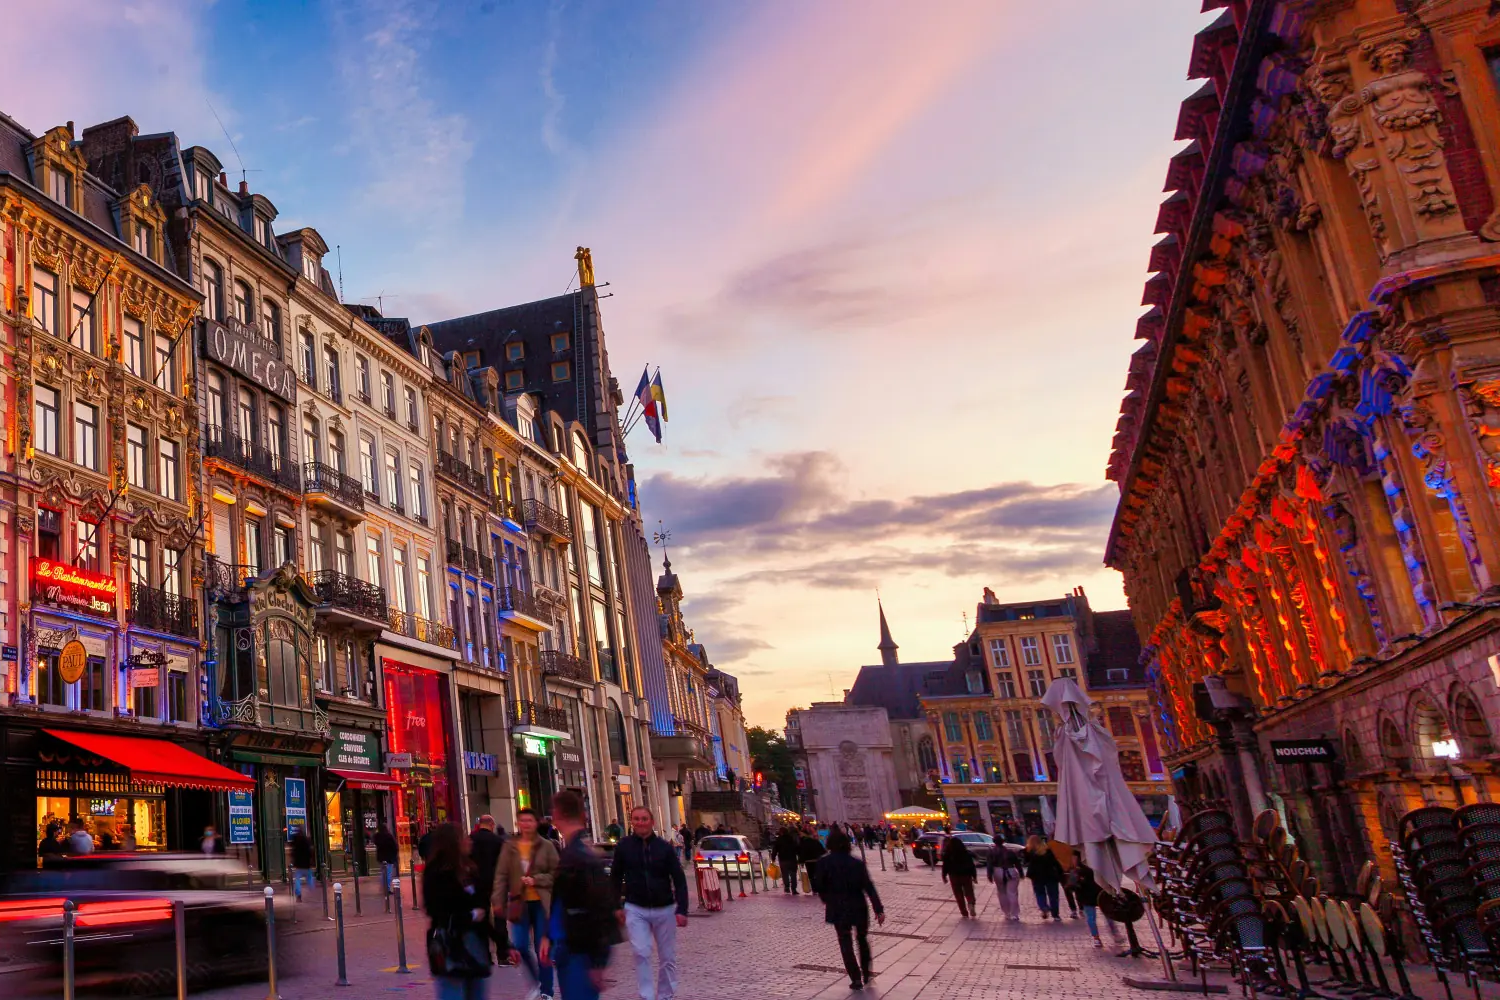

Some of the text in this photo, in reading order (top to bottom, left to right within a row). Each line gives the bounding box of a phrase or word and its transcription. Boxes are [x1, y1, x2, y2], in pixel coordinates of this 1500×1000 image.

[214, 326, 291, 399] OMEGA
[88, 595, 111, 613] Jean
[62, 653, 84, 669] PAUL
[406, 710, 426, 730] free
[562, 752, 580, 763] SEPHORA
[1275, 746, 1328, 757] NOUCHKA
